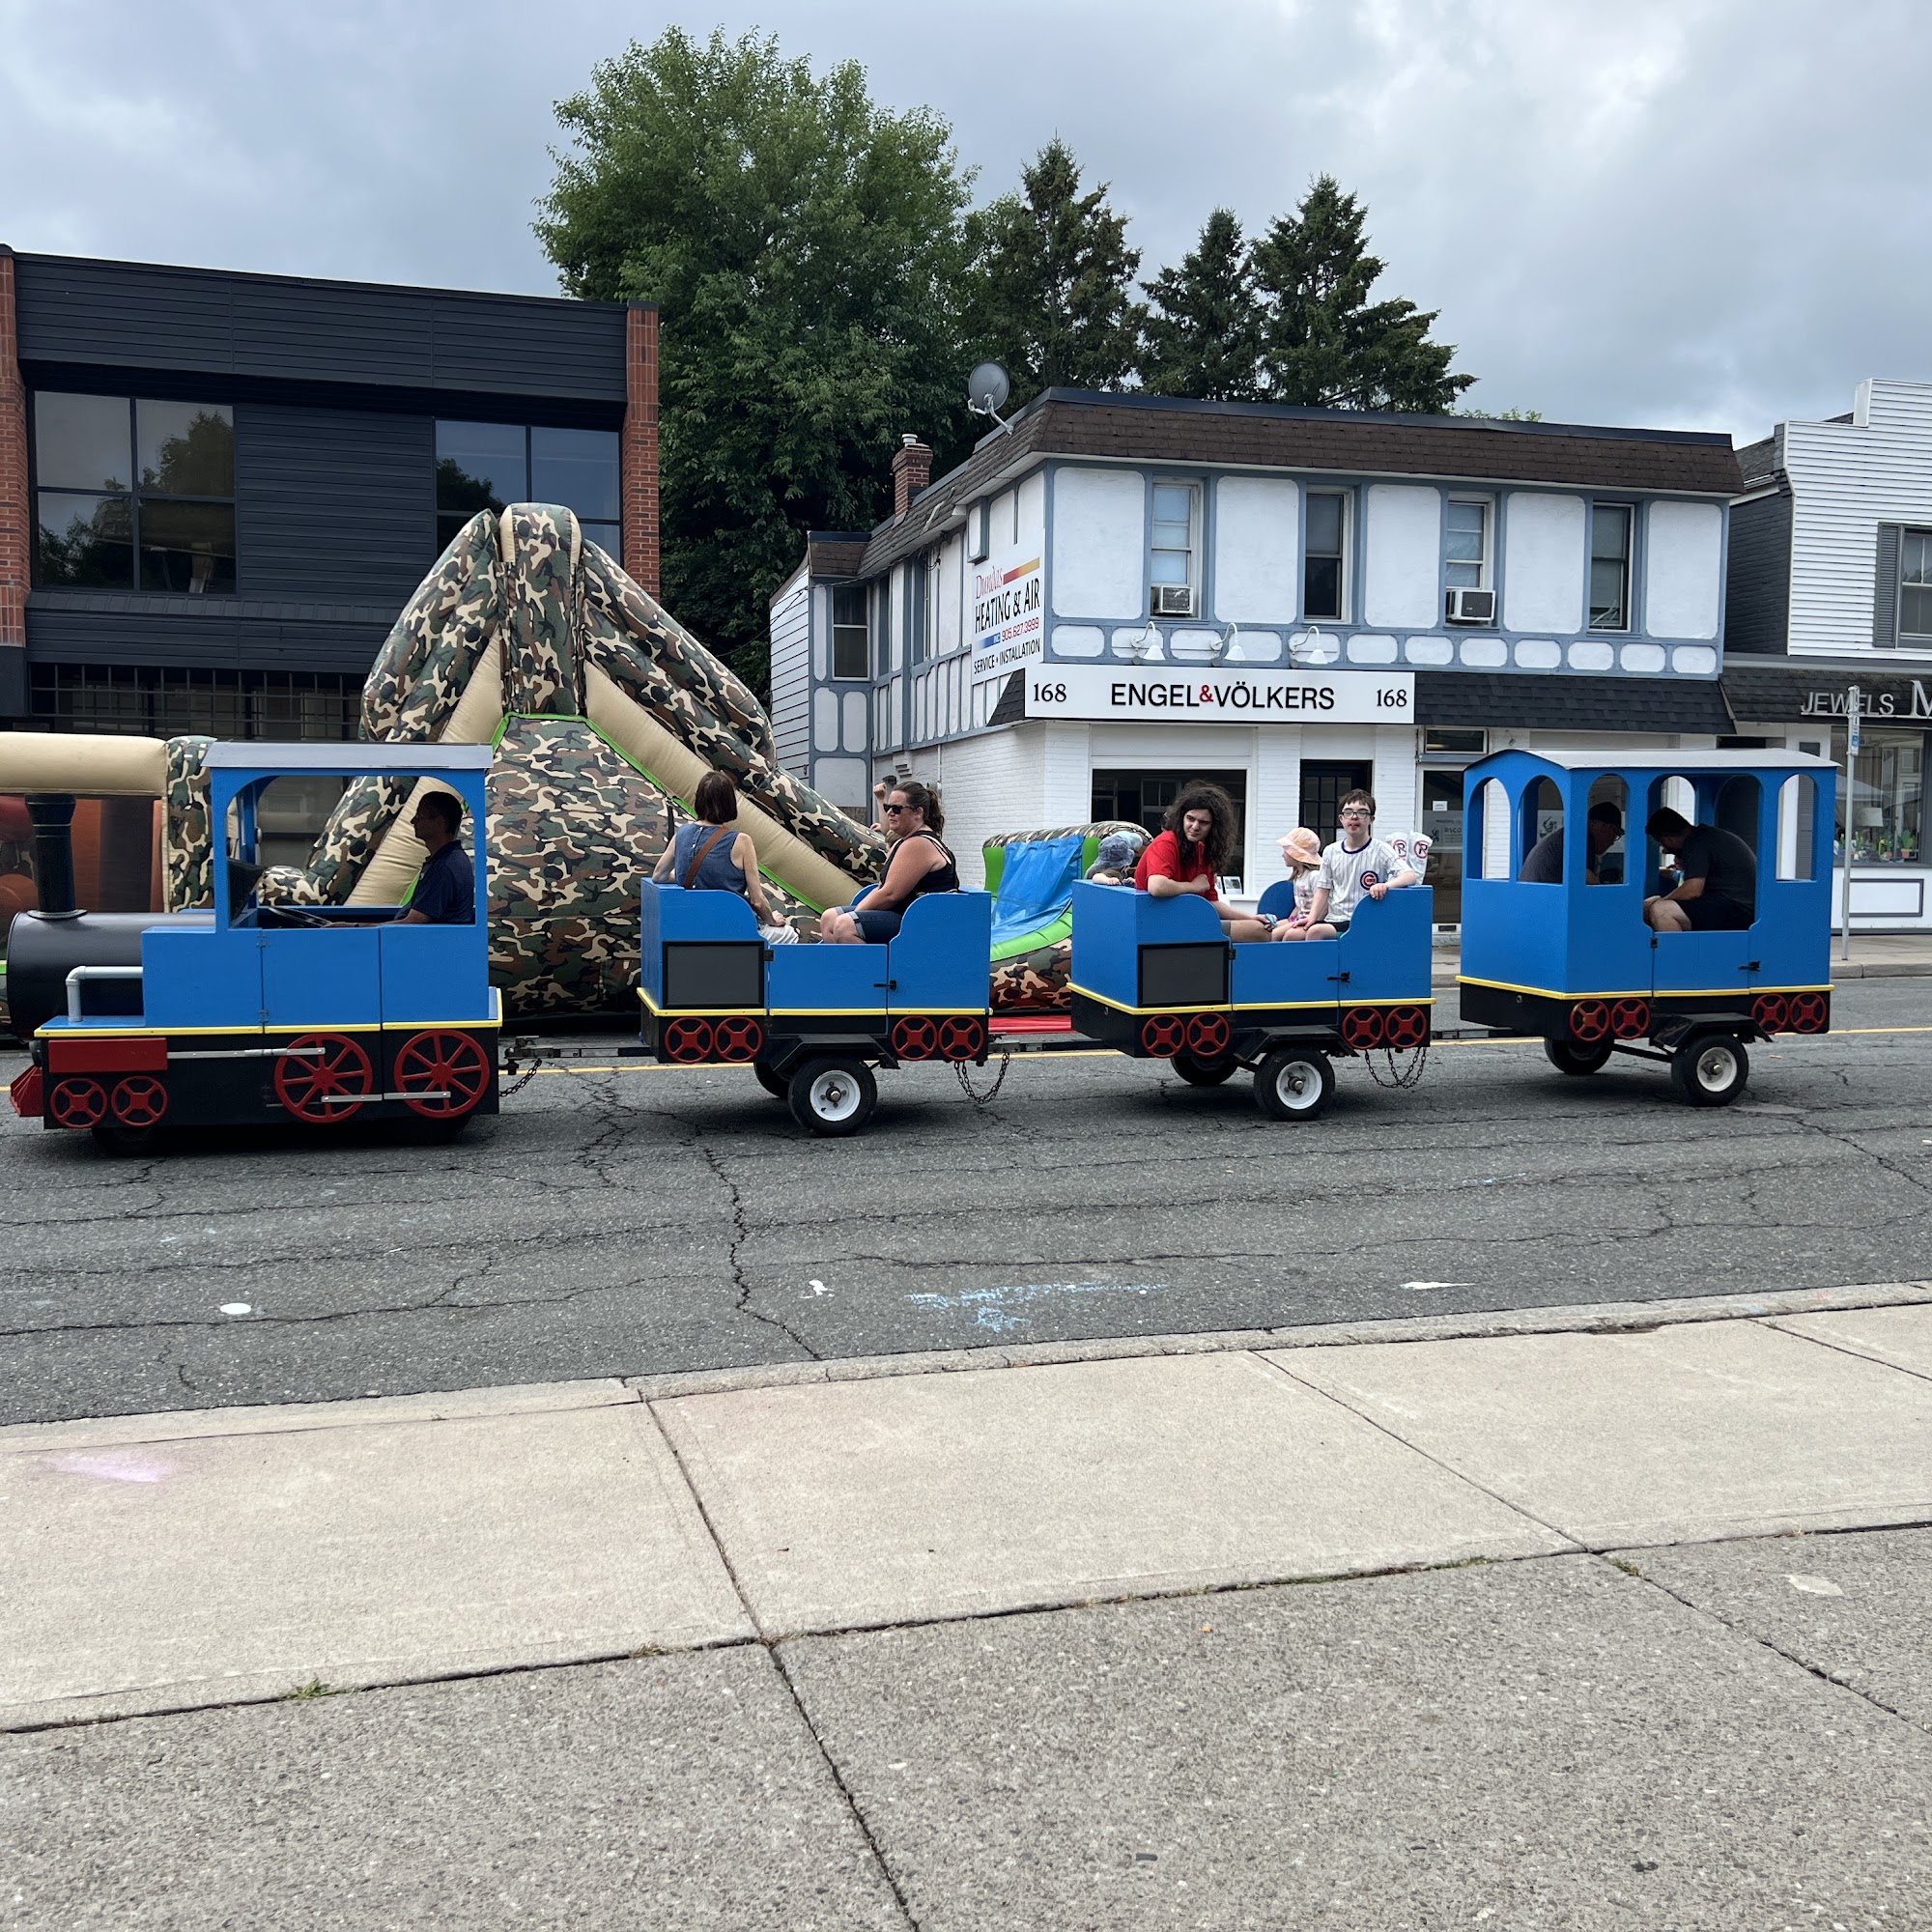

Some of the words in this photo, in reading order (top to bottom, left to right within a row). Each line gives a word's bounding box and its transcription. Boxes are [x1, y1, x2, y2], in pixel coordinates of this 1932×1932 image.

[975, 590, 1010, 634] HEATING
[1013, 590, 1021, 617] &
[1024, 578, 1040, 613] AIR
[974, 654, 995, 674] SERVICE
[999, 638, 1040, 666] INSTALLATION
[1034, 683, 1067, 702] 168
[1377, 689, 1407, 707] 168
